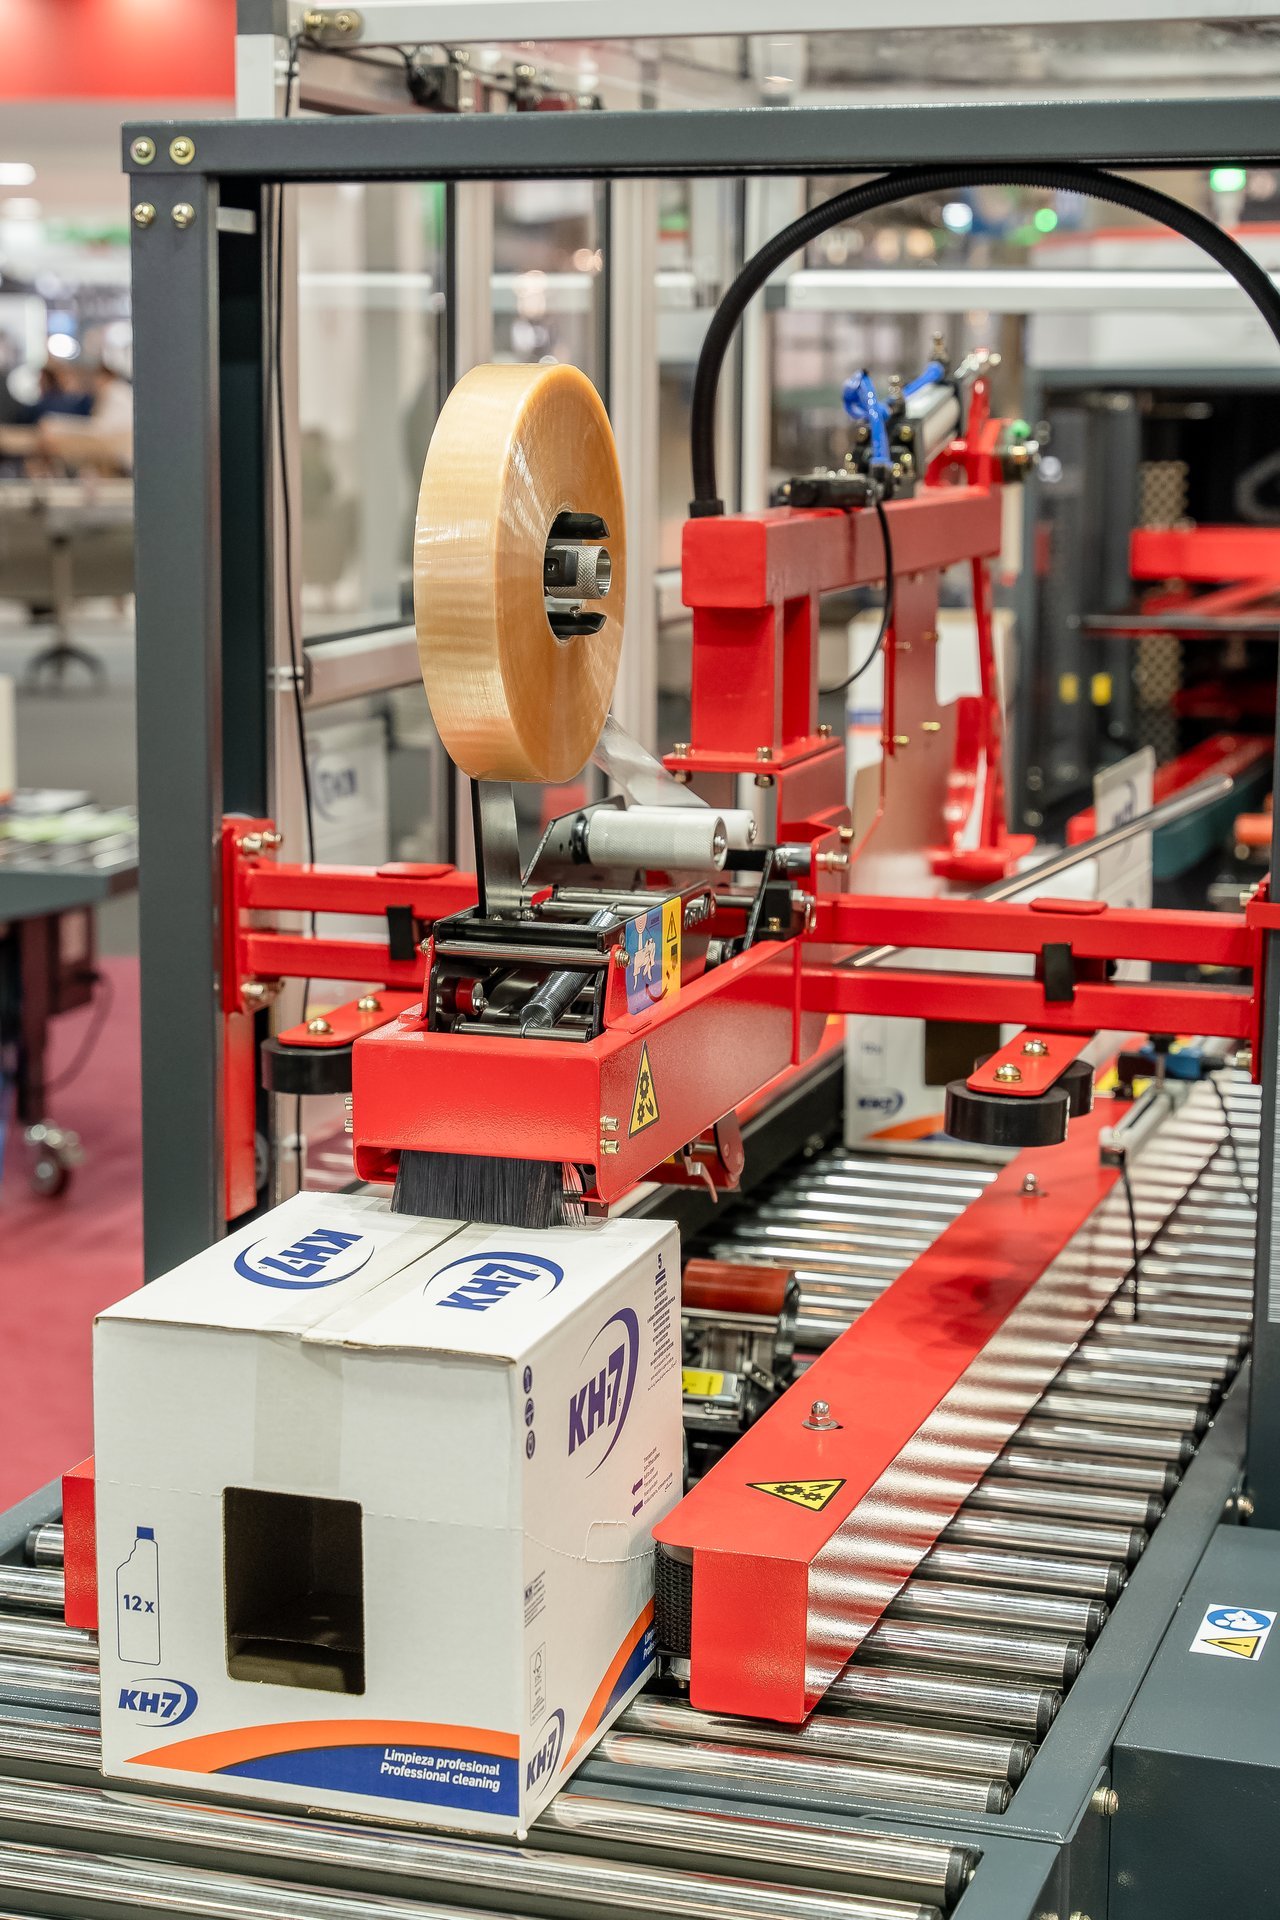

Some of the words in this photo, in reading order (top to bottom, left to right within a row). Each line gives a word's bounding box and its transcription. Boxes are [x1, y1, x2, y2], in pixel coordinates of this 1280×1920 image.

[380, 1761, 450, 1783] Professional
[452, 1773, 501, 1793] cleaning
[384, 1748, 434, 1766] Limpieza
[436, 1758, 500, 1776] profesional
